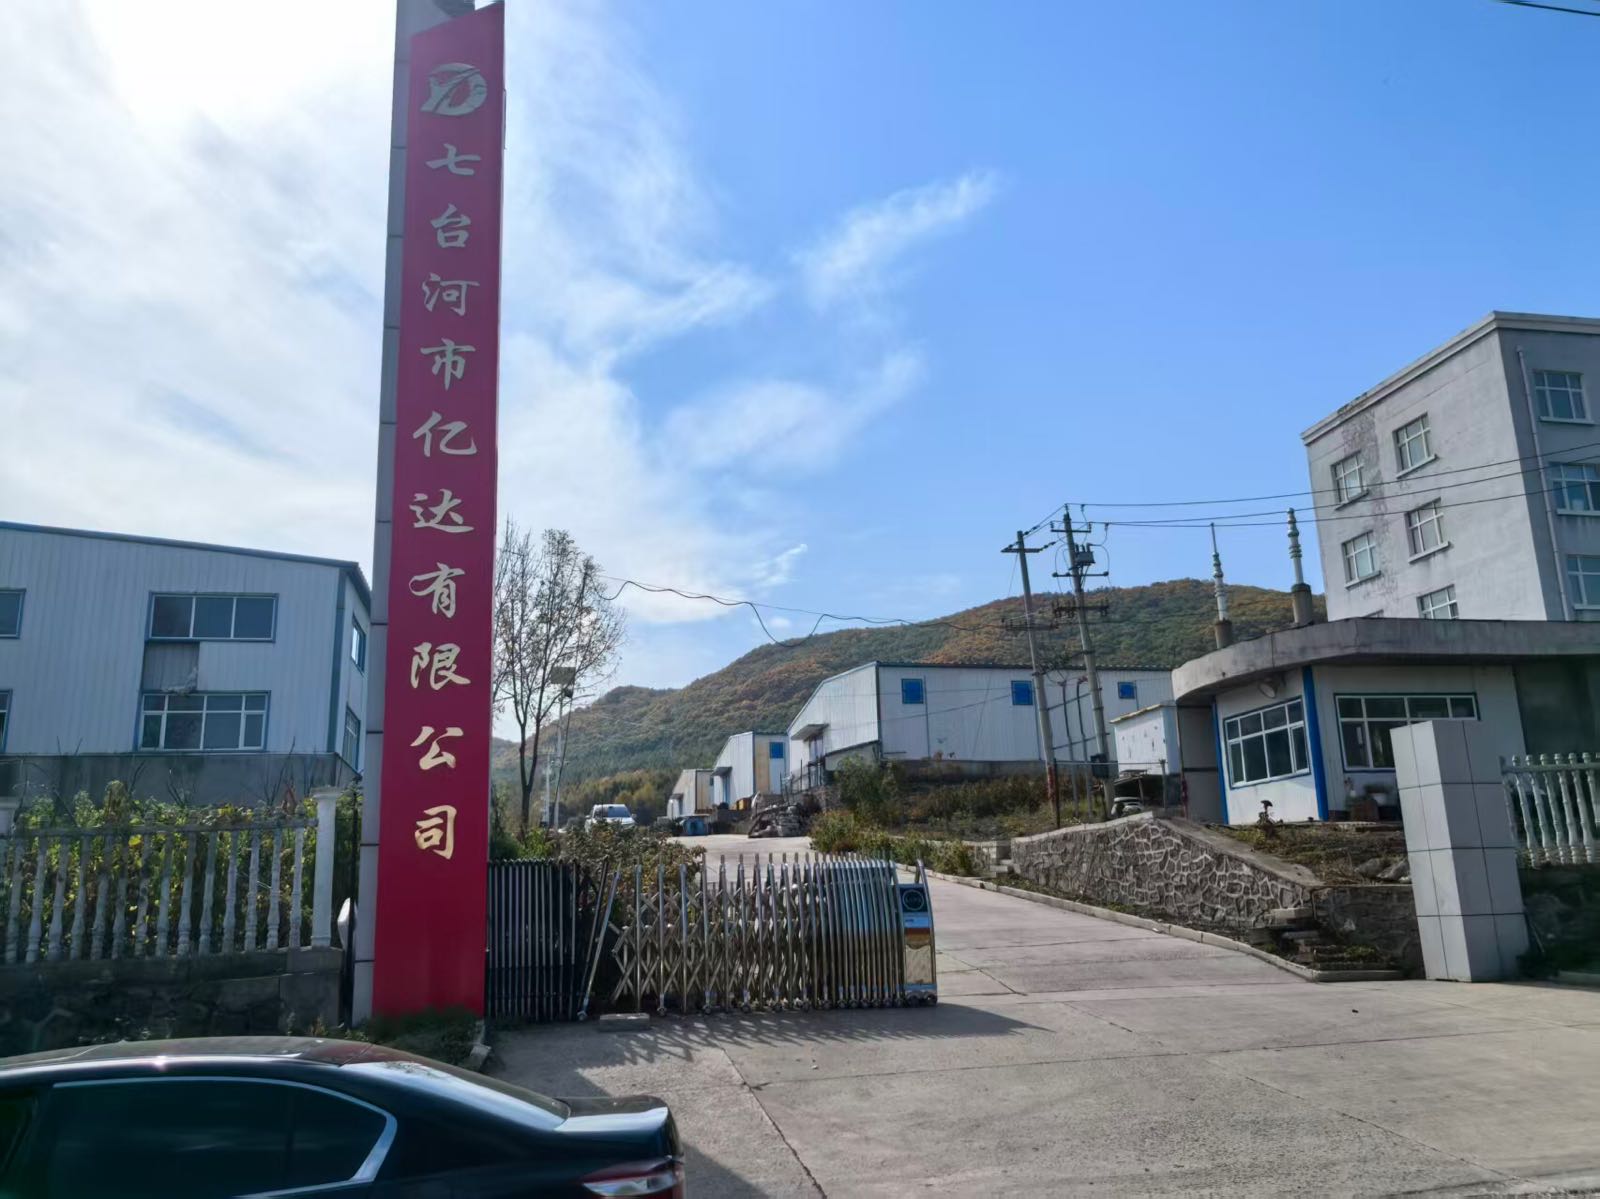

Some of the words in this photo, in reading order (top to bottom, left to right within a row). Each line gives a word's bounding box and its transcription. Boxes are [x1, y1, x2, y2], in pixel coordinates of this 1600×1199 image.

[409, 143, 481, 860] 七台河市亿达有限公司
